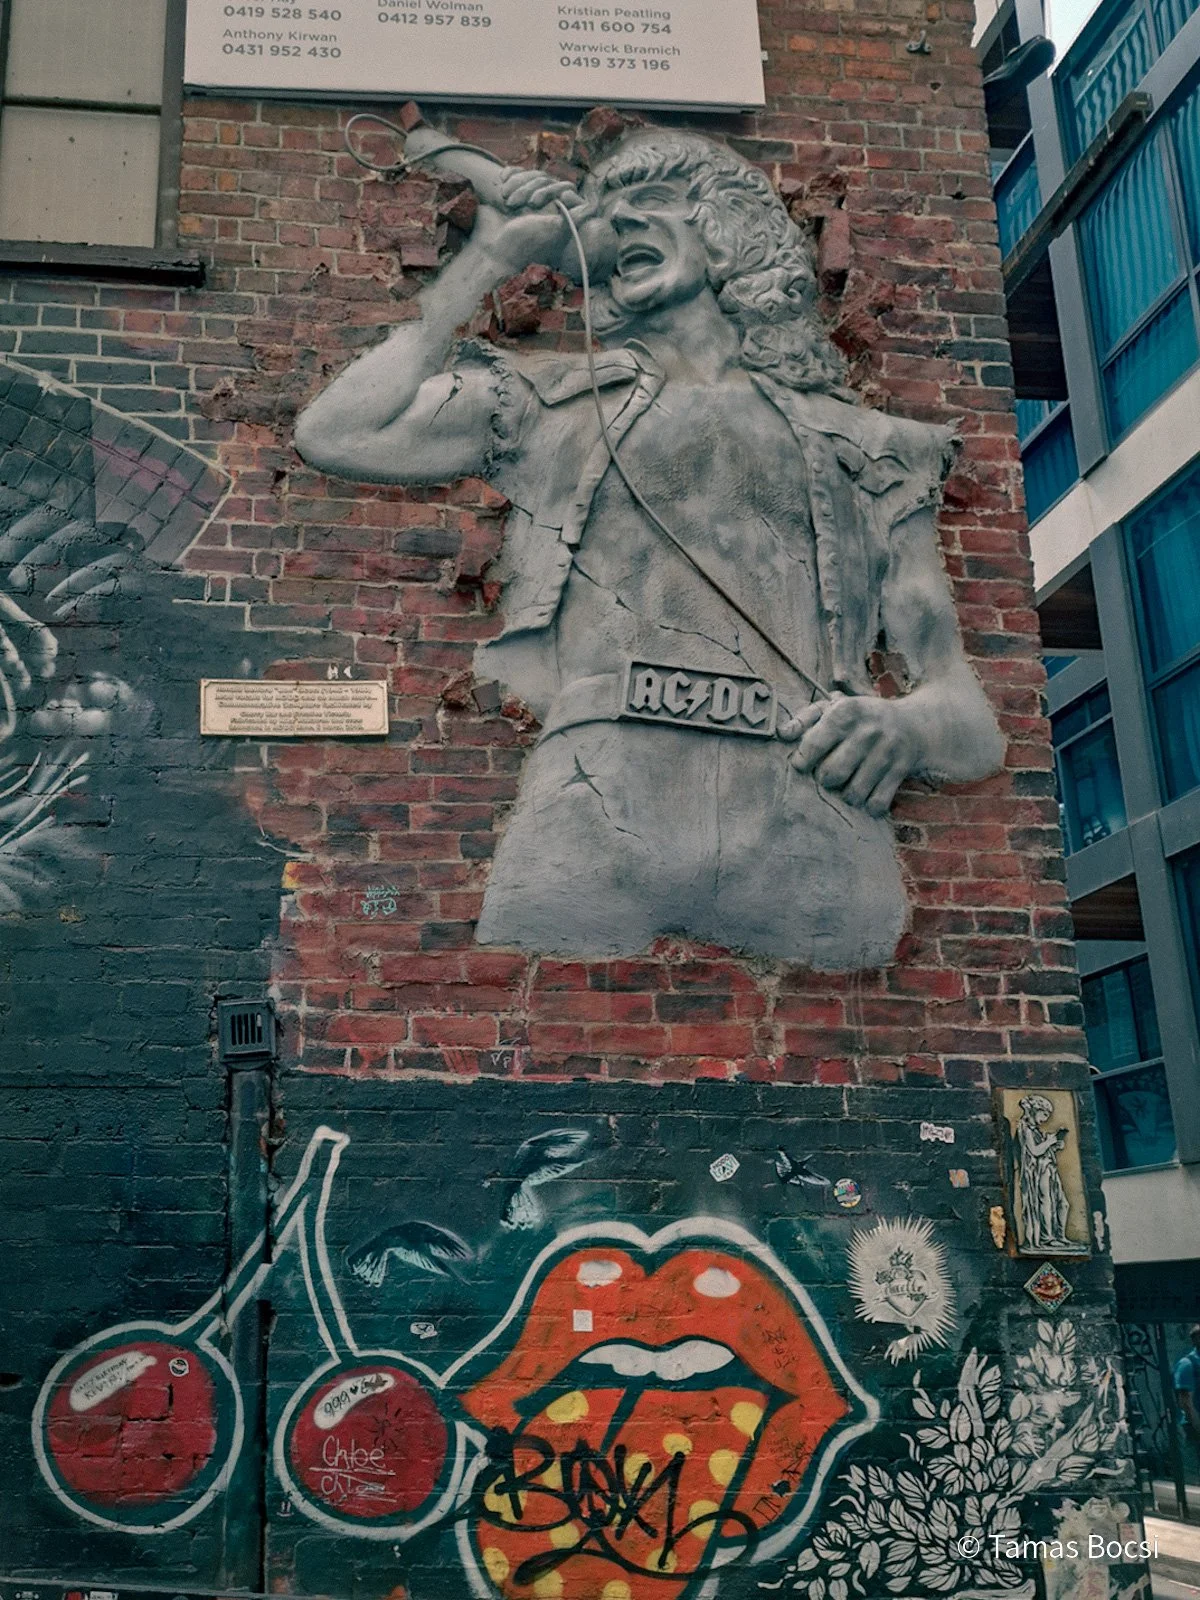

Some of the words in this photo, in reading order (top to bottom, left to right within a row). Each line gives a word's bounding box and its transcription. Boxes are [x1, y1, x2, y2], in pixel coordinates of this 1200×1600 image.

[377, 0, 421, 8] Daniel
[425, 0, 484, 11] Wolman
[223, 5, 265, 17] 0419
[271, 7, 302, 19] 528
[308, 9, 342, 21] 540
[377, 12, 418, 24] 0412
[424, 14, 455, 25] 957
[460, 16, 491, 27] 839
[557, 6, 610, 17] Kristian
[614, 8, 671, 20] Peatling
[558, 20, 595, 31] 0411
[601, 21, 635, 32] 600
[641, 23, 671, 34] 754
[222, 29, 283, 42] Anthony
[288, 31, 338, 42] Kirwan
[222, 43, 264, 55] 0431
[269, 45, 301, 57] 952
[307, 47, 342, 58] 430
[559, 42, 619, 53] Warwick
[624, 44, 680, 56] Bramich
[560, 56, 600, 68] 0419
[606, 58, 637, 69] 373
[642, 59, 671, 71] 196
